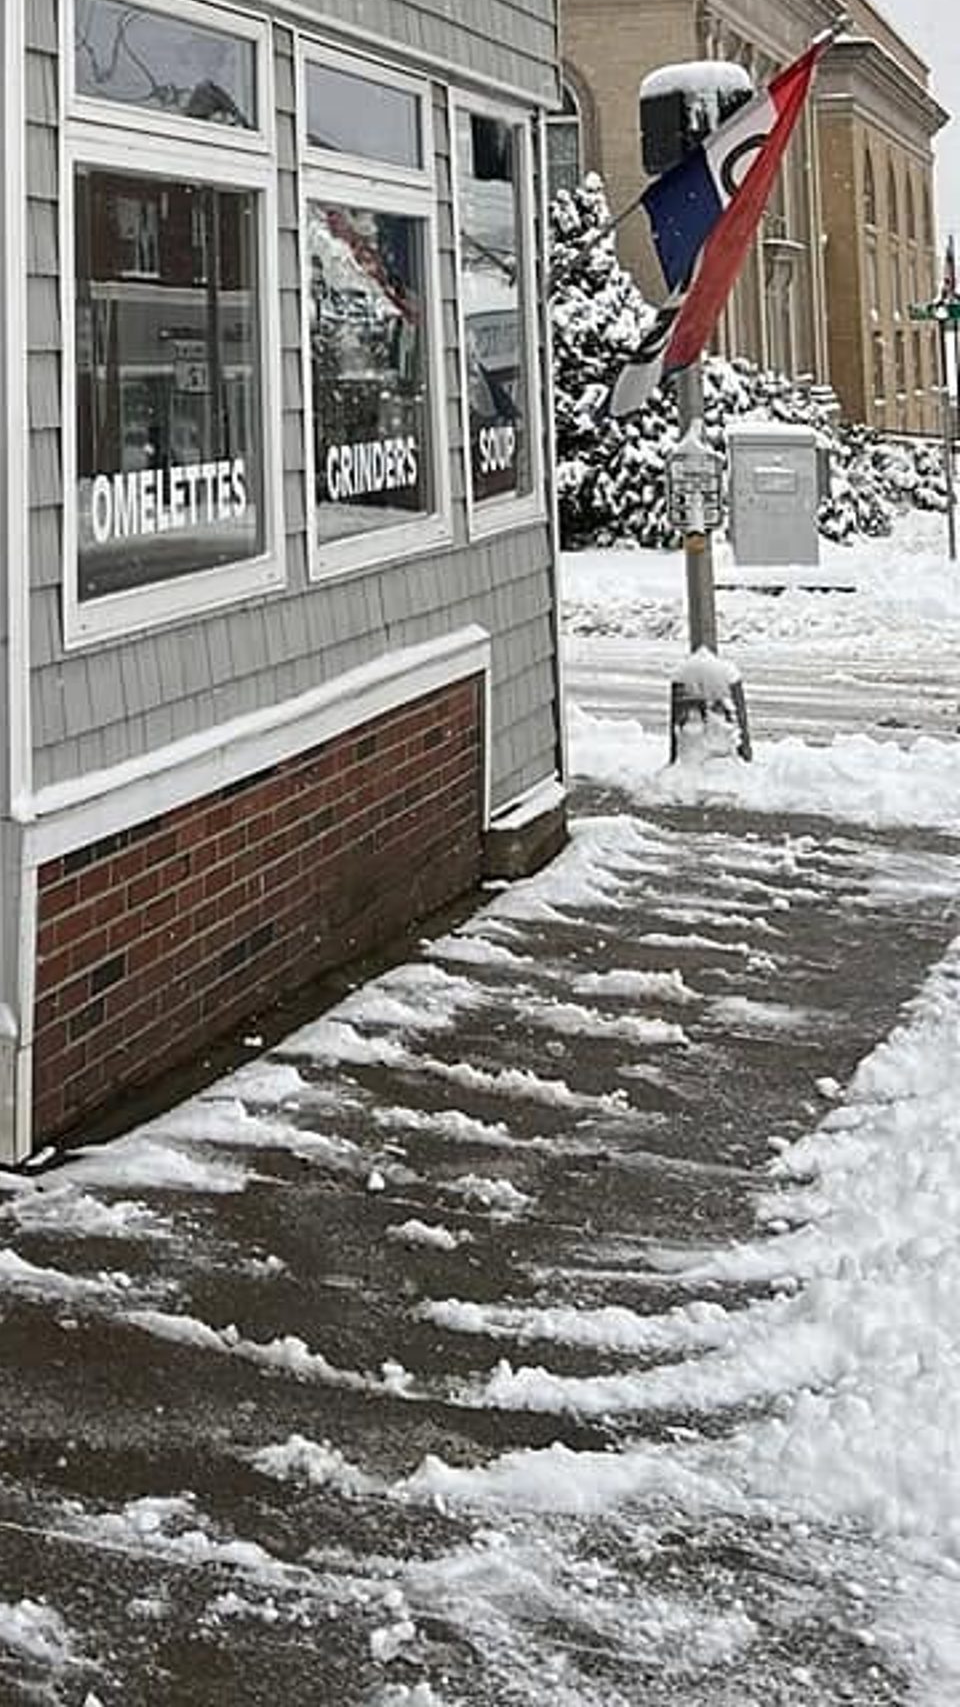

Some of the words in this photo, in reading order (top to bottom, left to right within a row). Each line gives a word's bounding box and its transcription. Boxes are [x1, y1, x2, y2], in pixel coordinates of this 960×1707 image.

[327, 436, 417, 500] GRINDERS
[480, 427, 515, 473] SOUP
[92, 460, 246, 543] OMELETTES
